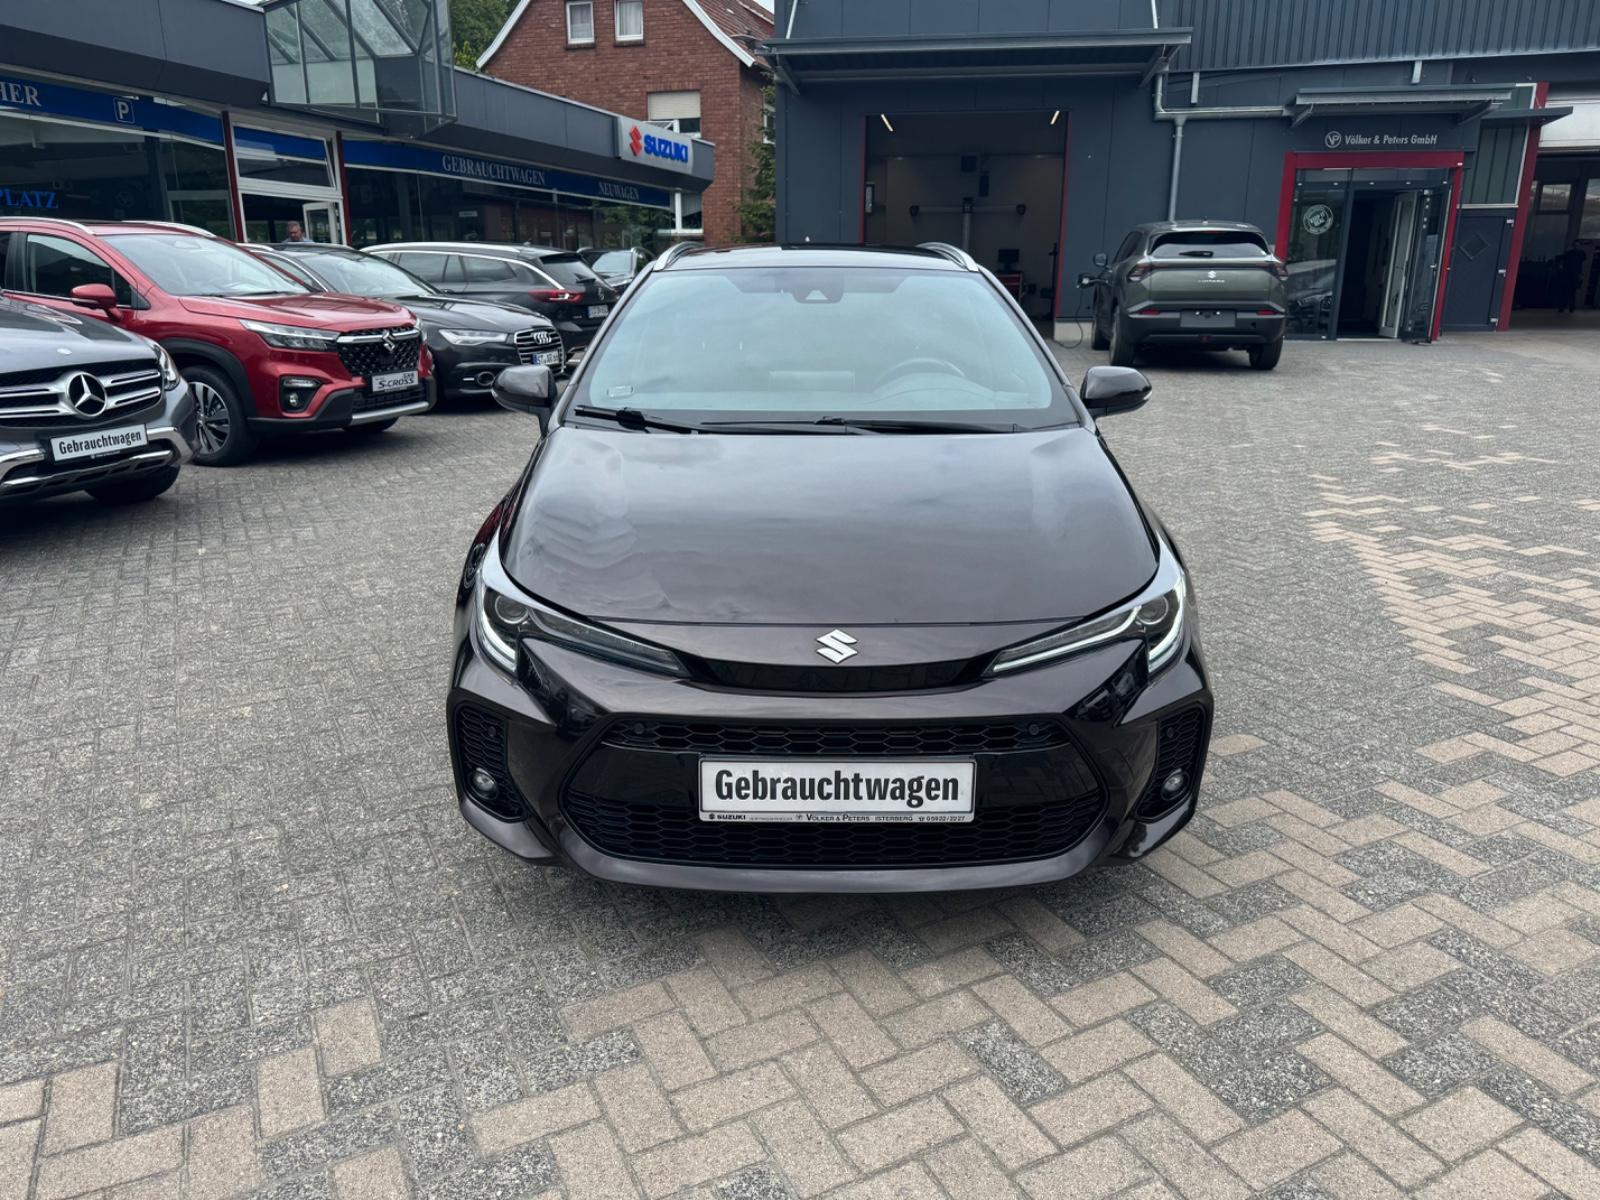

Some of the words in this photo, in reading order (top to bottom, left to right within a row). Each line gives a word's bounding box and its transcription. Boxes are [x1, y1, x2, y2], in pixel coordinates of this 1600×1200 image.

[643, 134, 689, 164] SUZUKI
[1345, 134, 1372, 145] Völker
[1373, 135, 1380, 145] &
[1383, 134, 1408, 145] Peters
[1411, 134, 1438, 145] GmbH
[441, 154, 546, 186] GEBRAUCHTWAGEN
[598, 181, 640, 201] NEUWAGEN
[59, 431, 142, 455] Gebrauchtwagen
[715, 769, 960, 809] Gebrauchtwagen
[842, 814, 871, 822] PETERS
